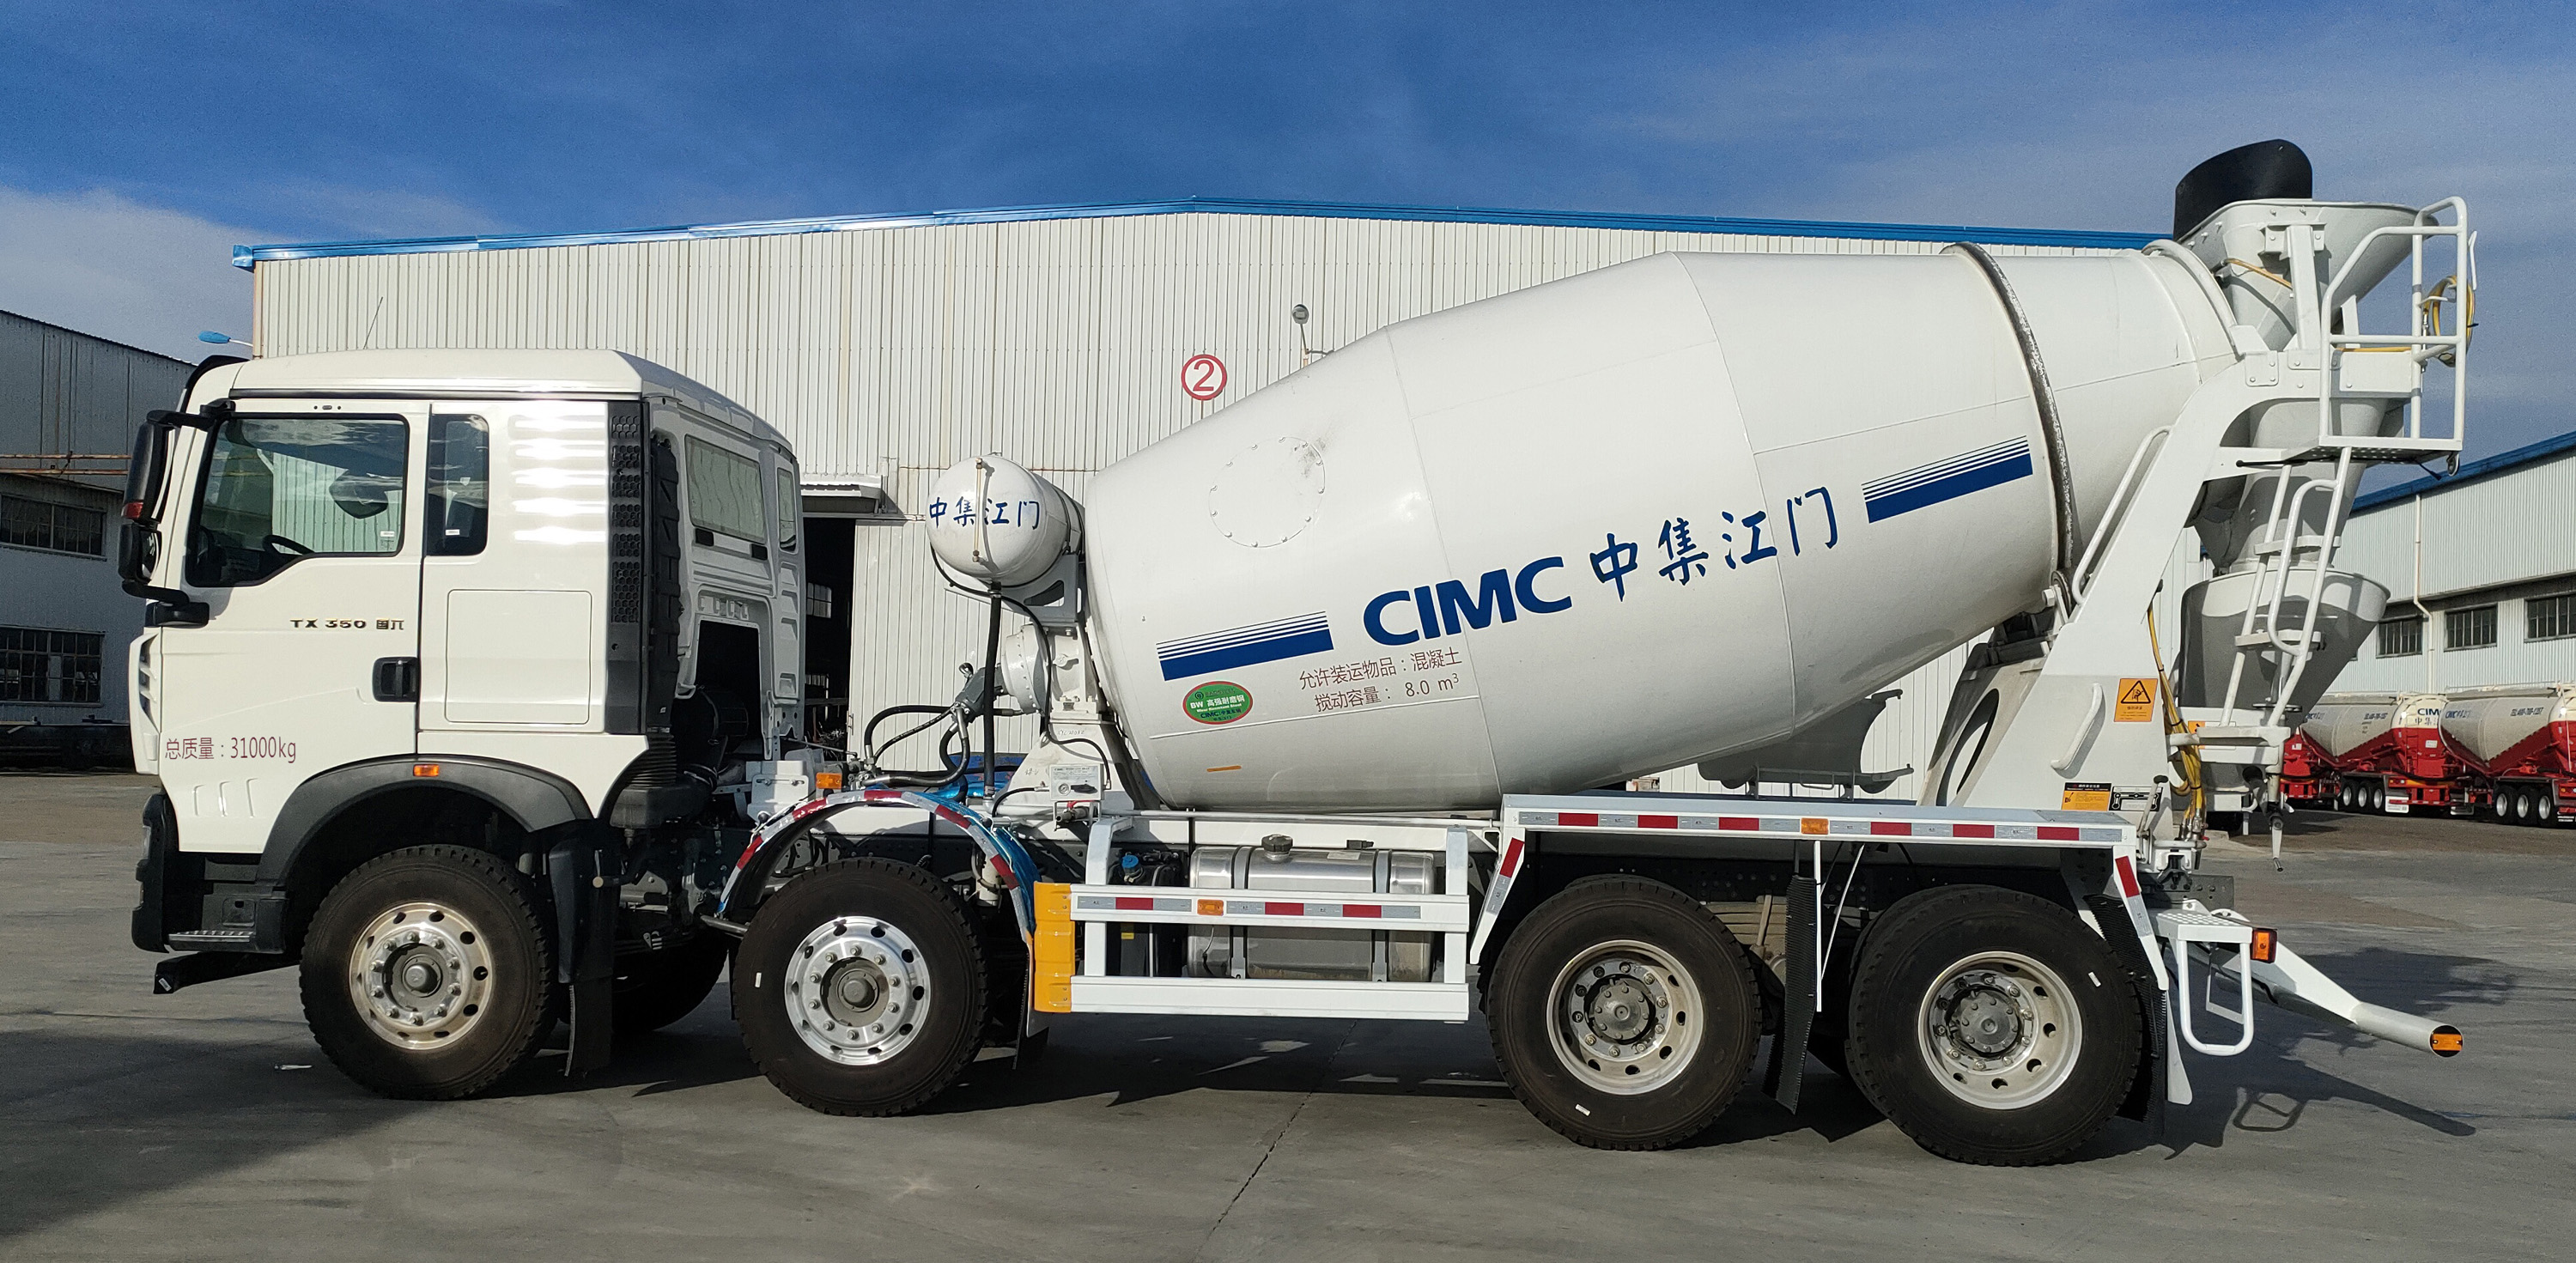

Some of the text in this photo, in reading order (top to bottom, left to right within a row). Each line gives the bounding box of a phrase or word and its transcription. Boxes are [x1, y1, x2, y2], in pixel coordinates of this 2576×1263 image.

[1193, 360, 1214, 391] 2
[929, 496, 1040, 530] 中集江门
[1364, 487, 1838, 646] CIMC 中集江门
[290, 618, 318, 628] TX
[325, 618, 367, 628] 350
[1405, 680, 1431, 697] 8.0
